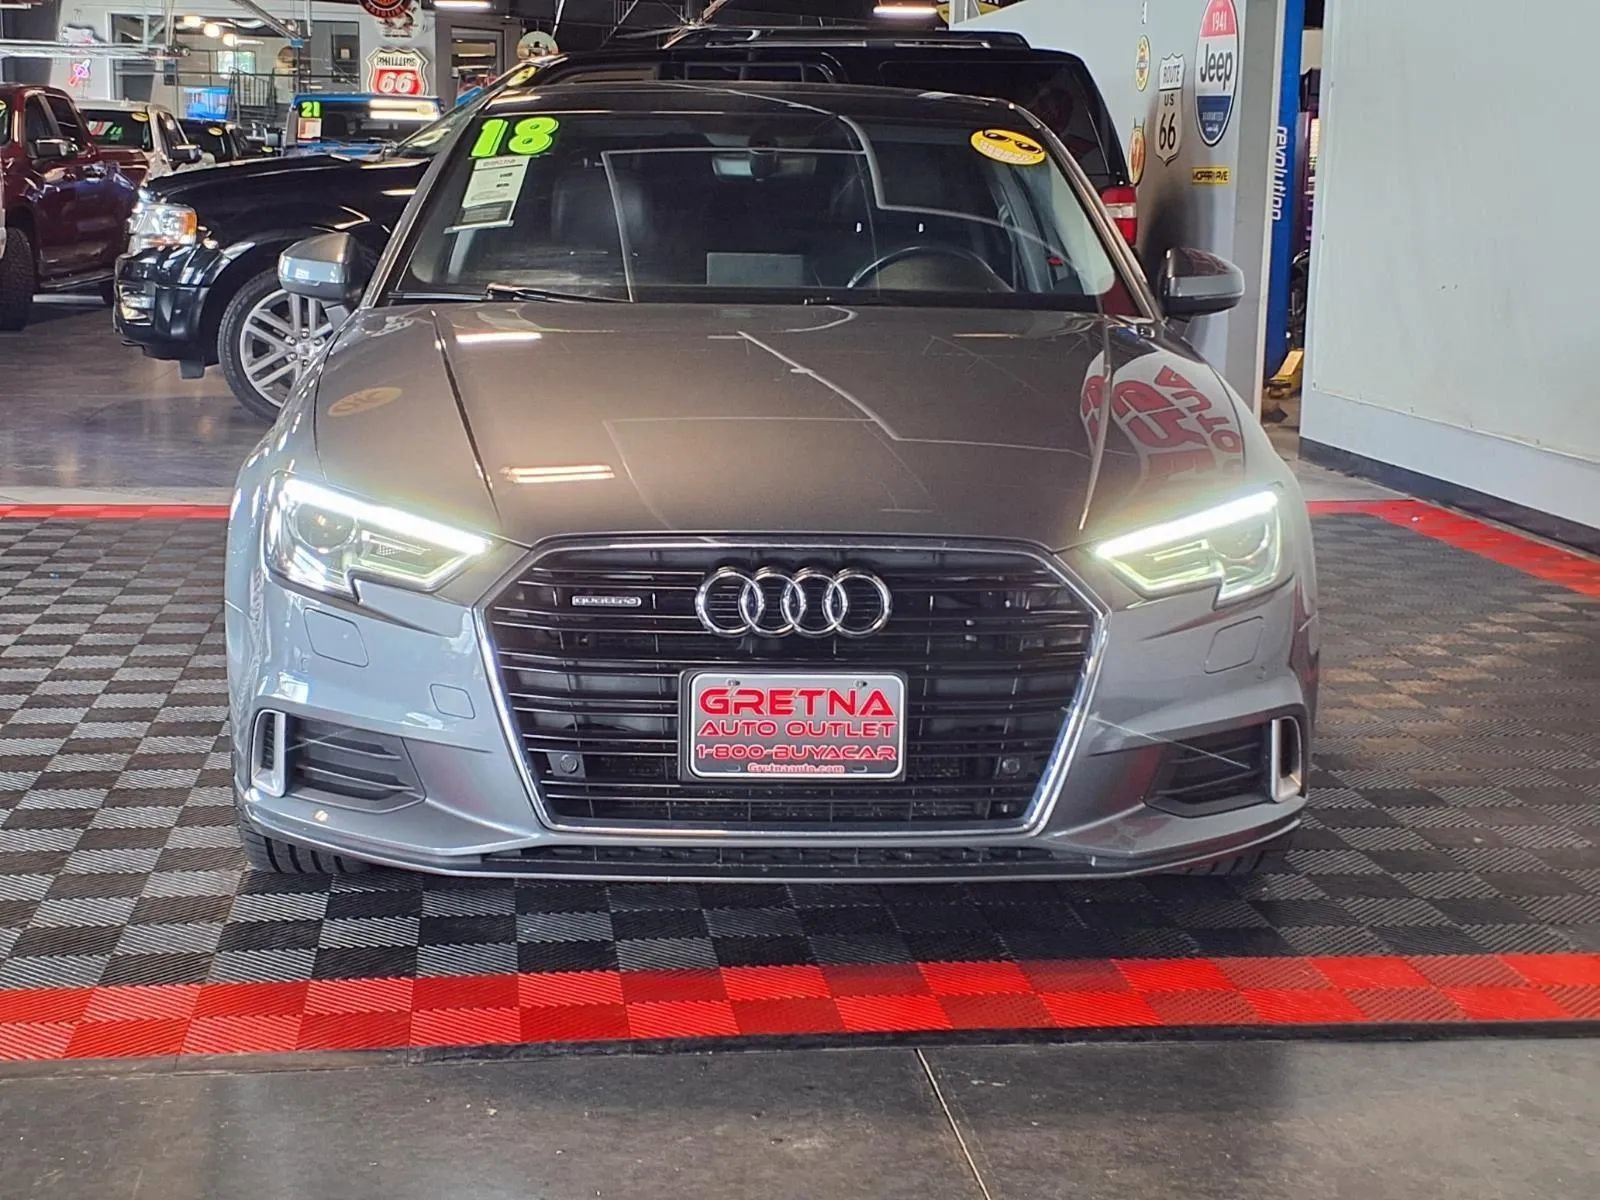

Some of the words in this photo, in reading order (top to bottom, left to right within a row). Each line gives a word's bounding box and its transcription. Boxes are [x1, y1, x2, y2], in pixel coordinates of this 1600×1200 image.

[1212, 10, 1227, 31] 1941
[375, 56, 417, 67] PHILLIPS
[1199, 43, 1233, 91] Jeep
[378, 72, 416, 93] 66
[1163, 64, 1181, 84] ROUTE
[301, 101, 320, 118] 21
[1163, 93, 1175, 107] US
[471, 117, 560, 157] 18
[1159, 113, 1176, 150] 66
[1272, 126, 1288, 221] revolution
[699, 687, 896, 717] GRETNA
[697, 720, 777, 737] AUTO
[785, 720, 897, 737] OUTLET
[696, 744, 896, 760] 1-800-BUYACAR
